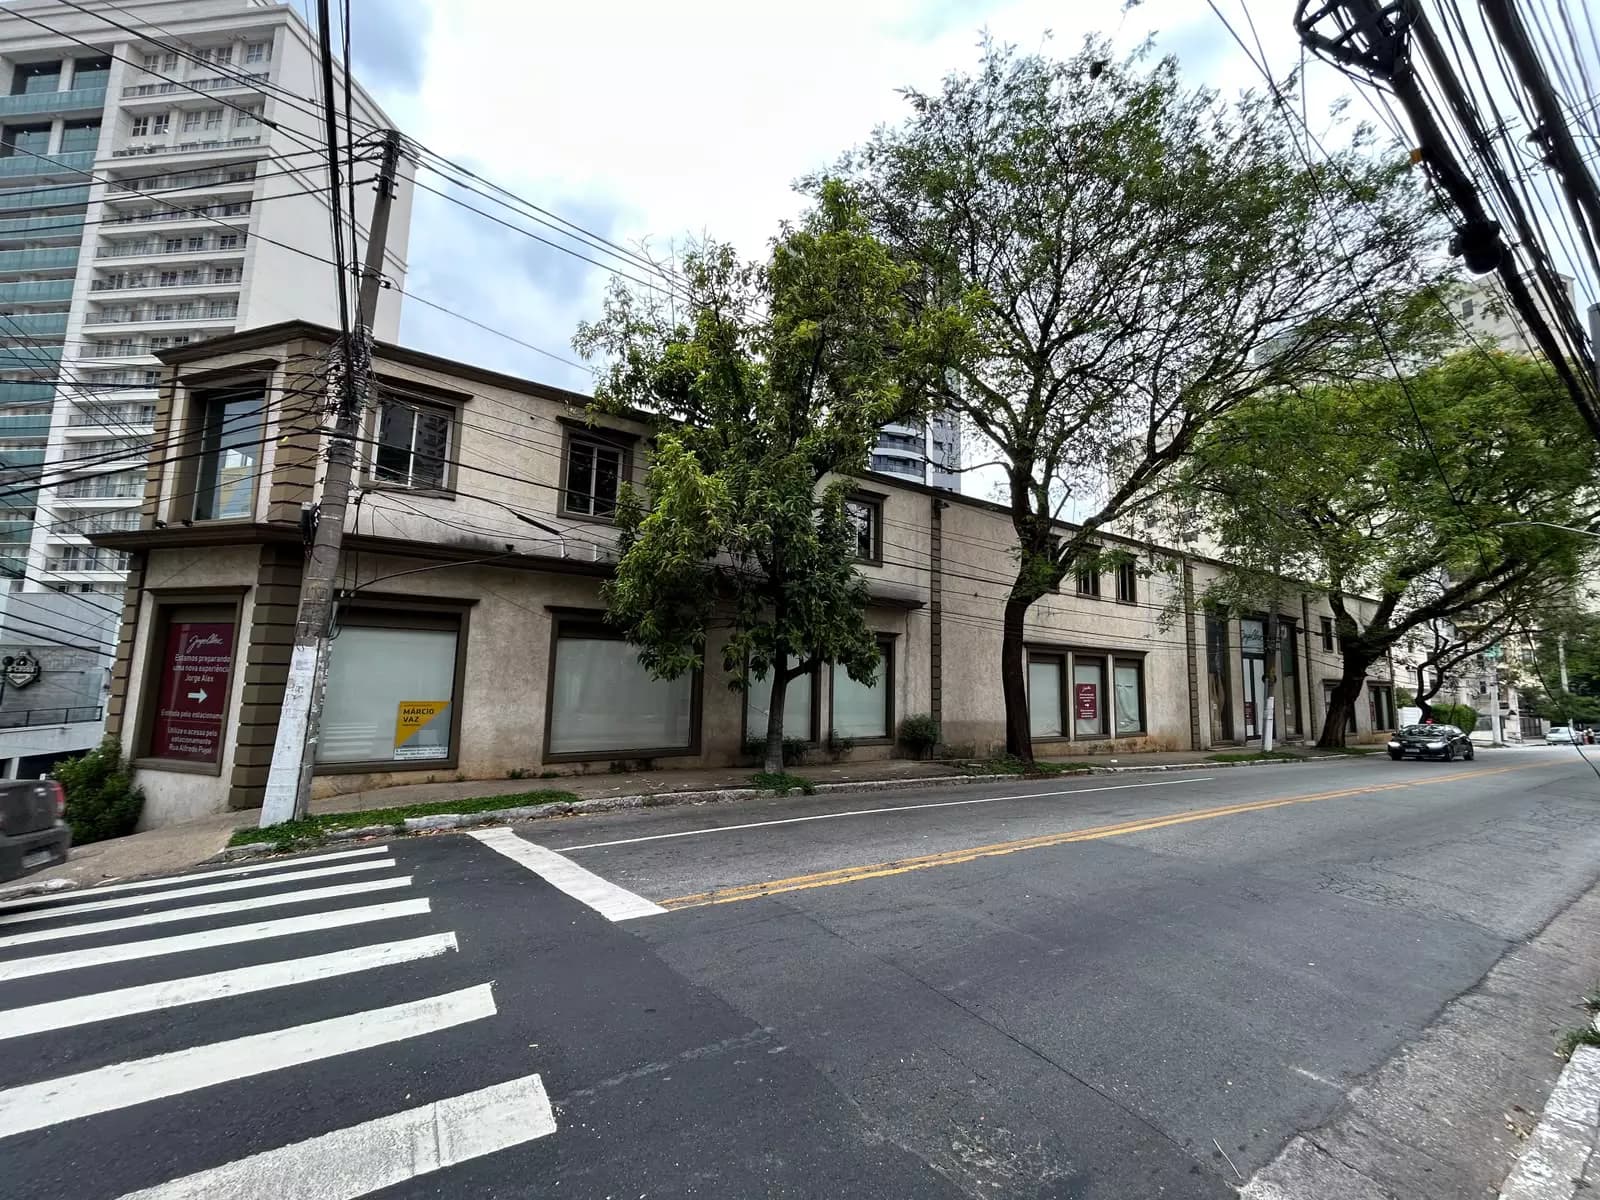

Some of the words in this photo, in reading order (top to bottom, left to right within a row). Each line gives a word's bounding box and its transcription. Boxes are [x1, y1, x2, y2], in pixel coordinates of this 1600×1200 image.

[175, 653, 198, 662] Estamos
[199, 655, 231, 663] preparando
[184, 674, 201, 683] Jorge
[201, 674, 214, 682] Alex
[403, 706, 434, 715] MÁRCIO
